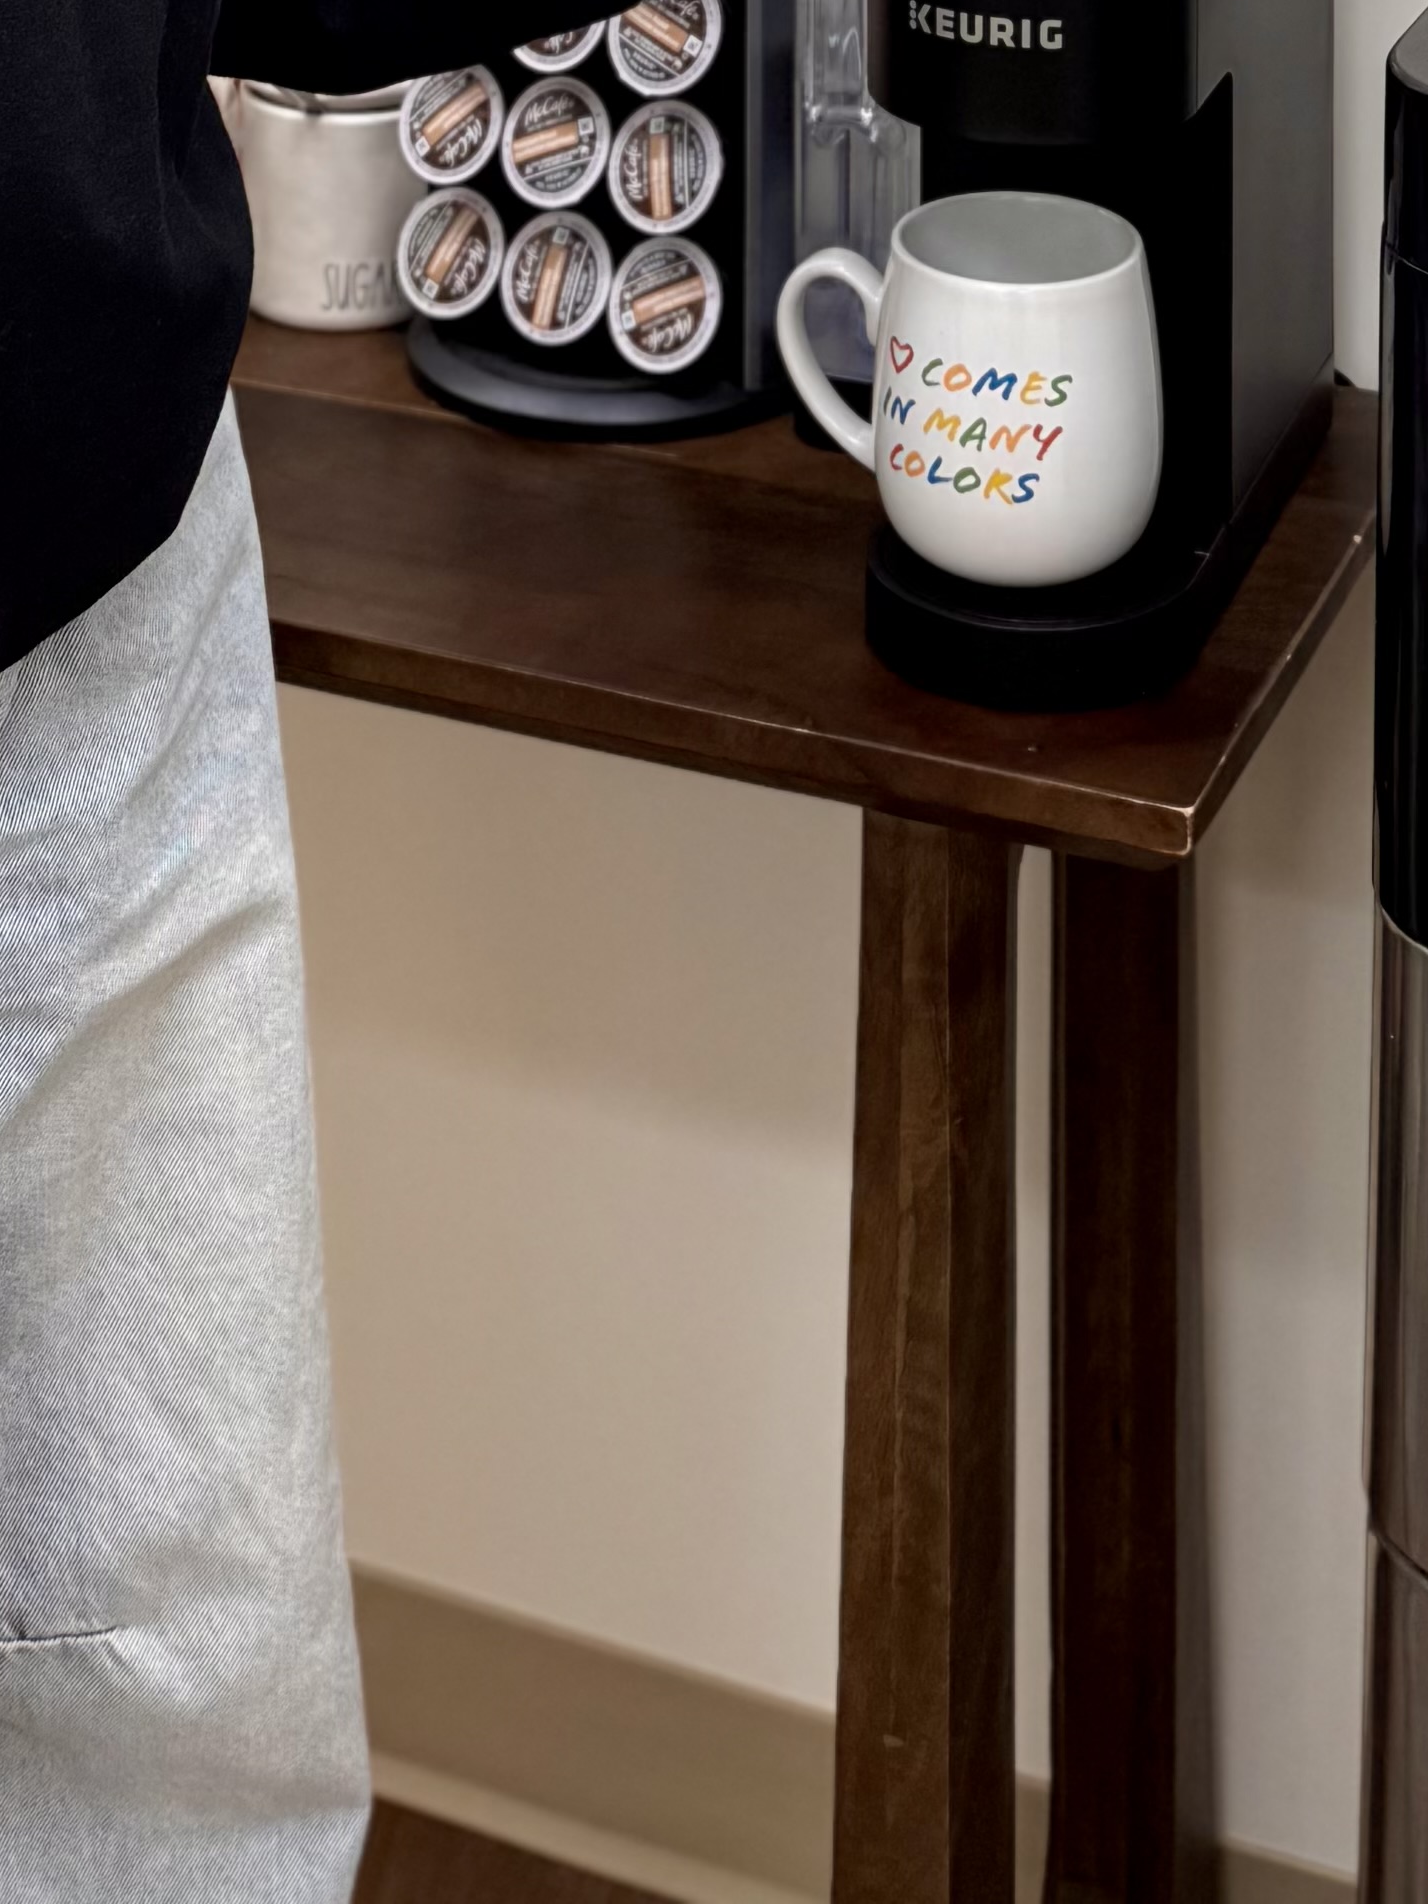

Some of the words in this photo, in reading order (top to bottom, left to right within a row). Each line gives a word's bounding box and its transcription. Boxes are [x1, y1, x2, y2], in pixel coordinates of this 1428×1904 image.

[909, 0, 1063, 50] KEURIG
[883, 386, 916, 425] IN
[921, 358, 1073, 407] COMES
[923, 407, 1063, 461] MANY
[889, 443, 1040, 504] COLORS
